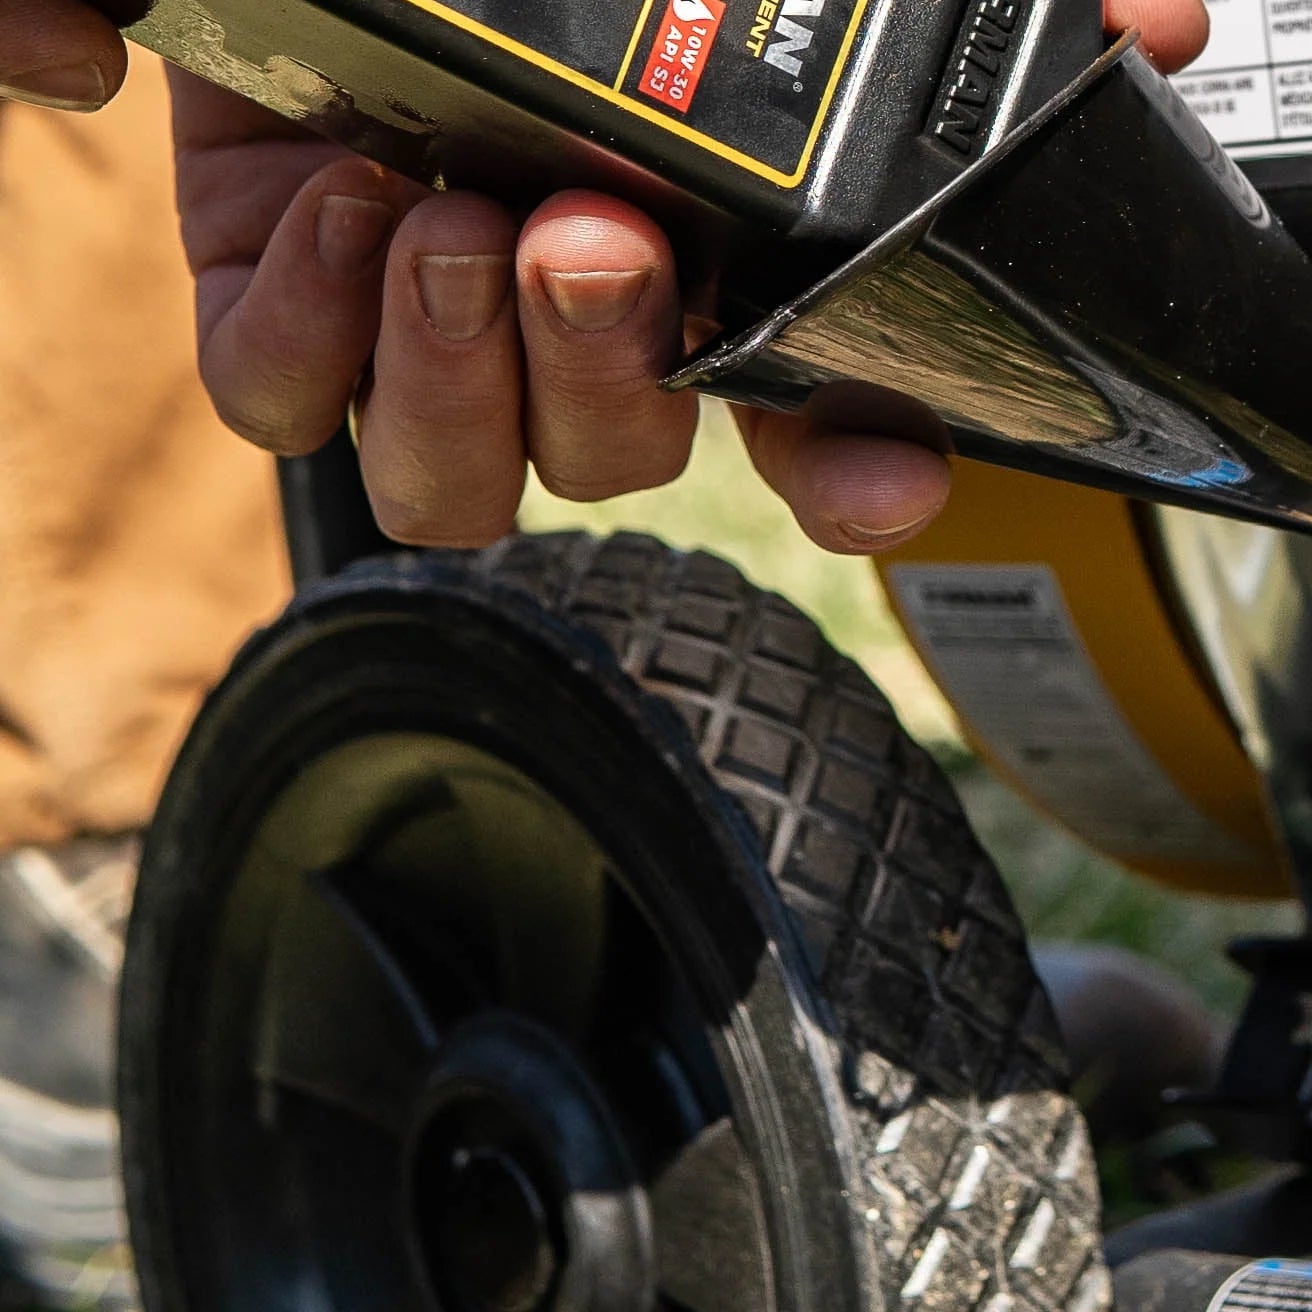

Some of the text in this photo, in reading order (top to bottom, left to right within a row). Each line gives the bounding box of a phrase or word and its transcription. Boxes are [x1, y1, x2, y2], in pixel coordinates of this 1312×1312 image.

[649, 23, 683, 92] API SJ
[668, 25, 707, 99] 10W-30
